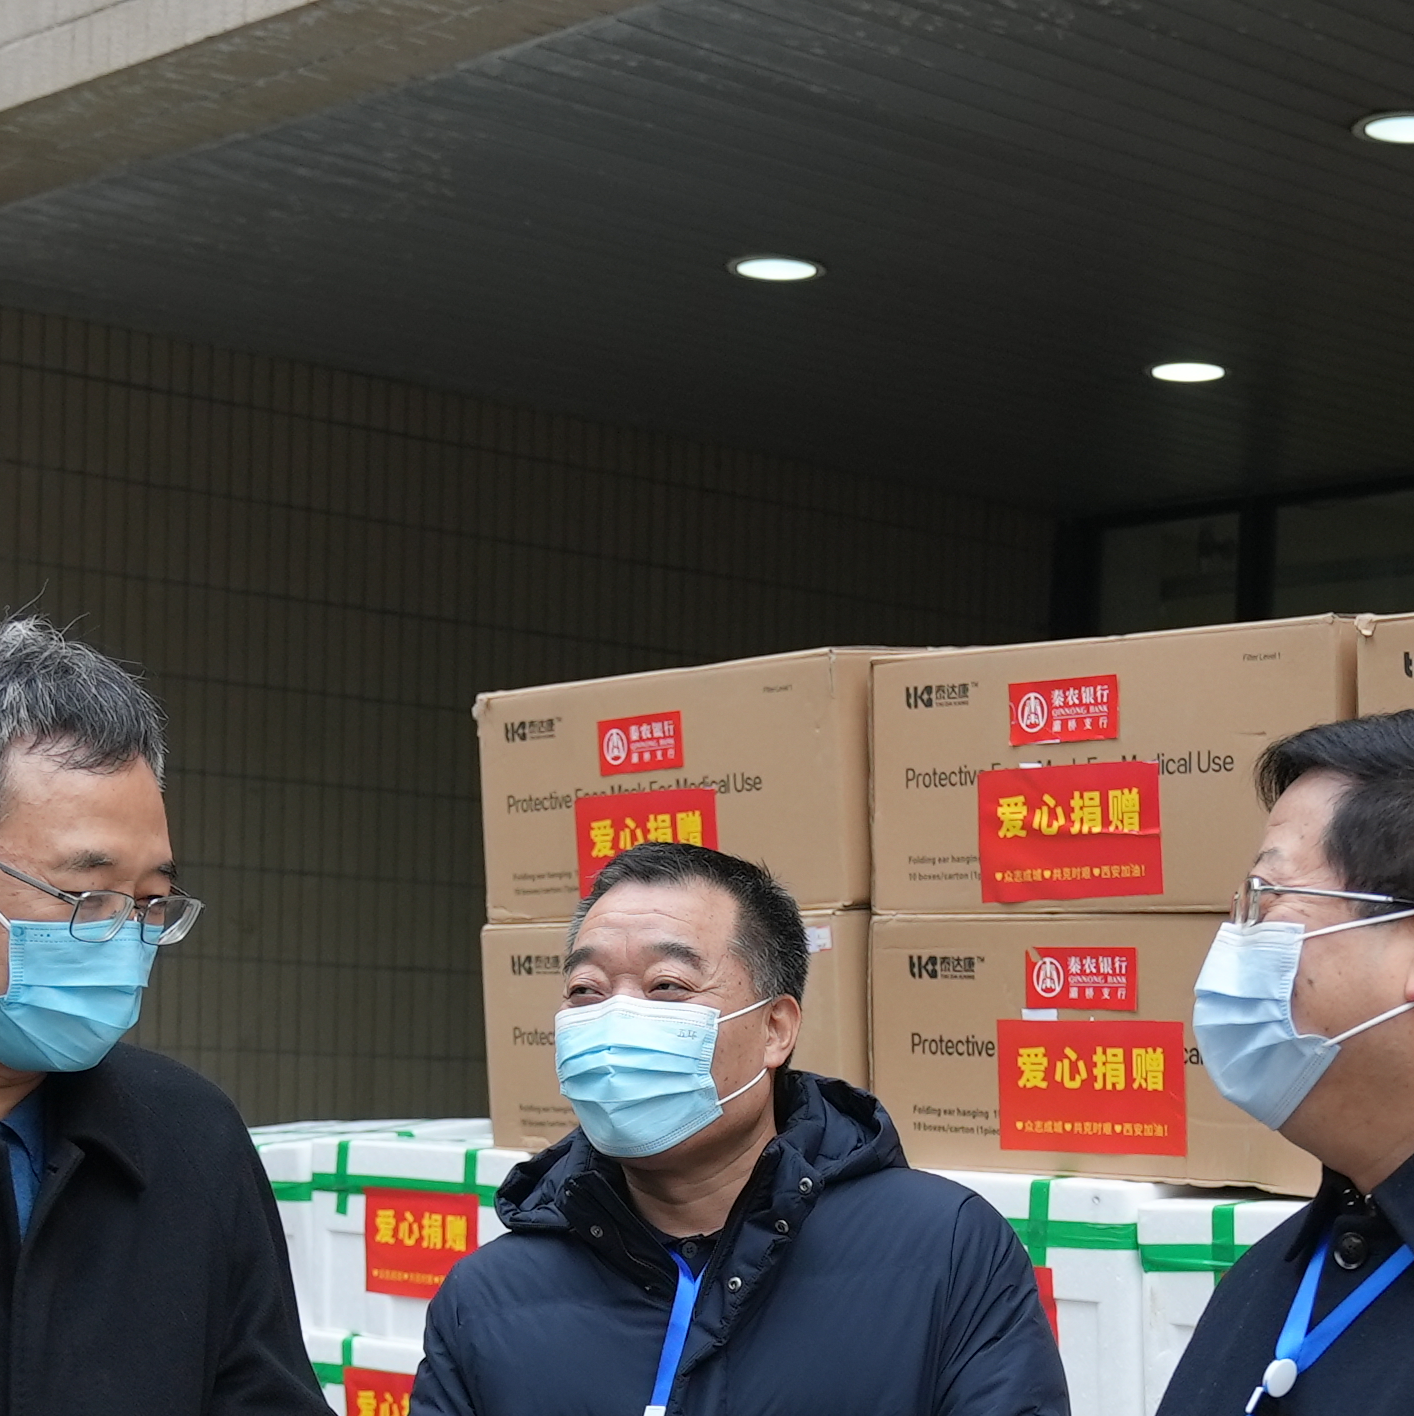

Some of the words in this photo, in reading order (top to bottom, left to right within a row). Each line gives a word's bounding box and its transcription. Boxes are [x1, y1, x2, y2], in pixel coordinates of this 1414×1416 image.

[1051, 684, 1110, 707] 秦农银行
[1197, 750, 1235, 774] Use
[507, 791, 573, 814] Protective
[733, 772, 762, 793] Use
[996, 787, 1140, 838] 爱心捐赠
[939, 956, 975, 973] 泰达康
[1067, 956, 1128, 975] 秦农银行
[911, 1032, 996, 1057] Protective
[1017, 1046, 1165, 1091] 爱心捐赠
[1024, 1121, 1064, 1134] 众志成城
[1073, 1122, 1113, 1136] 共克时艰
[375, 1209, 467, 1252] 爱心捐赠
